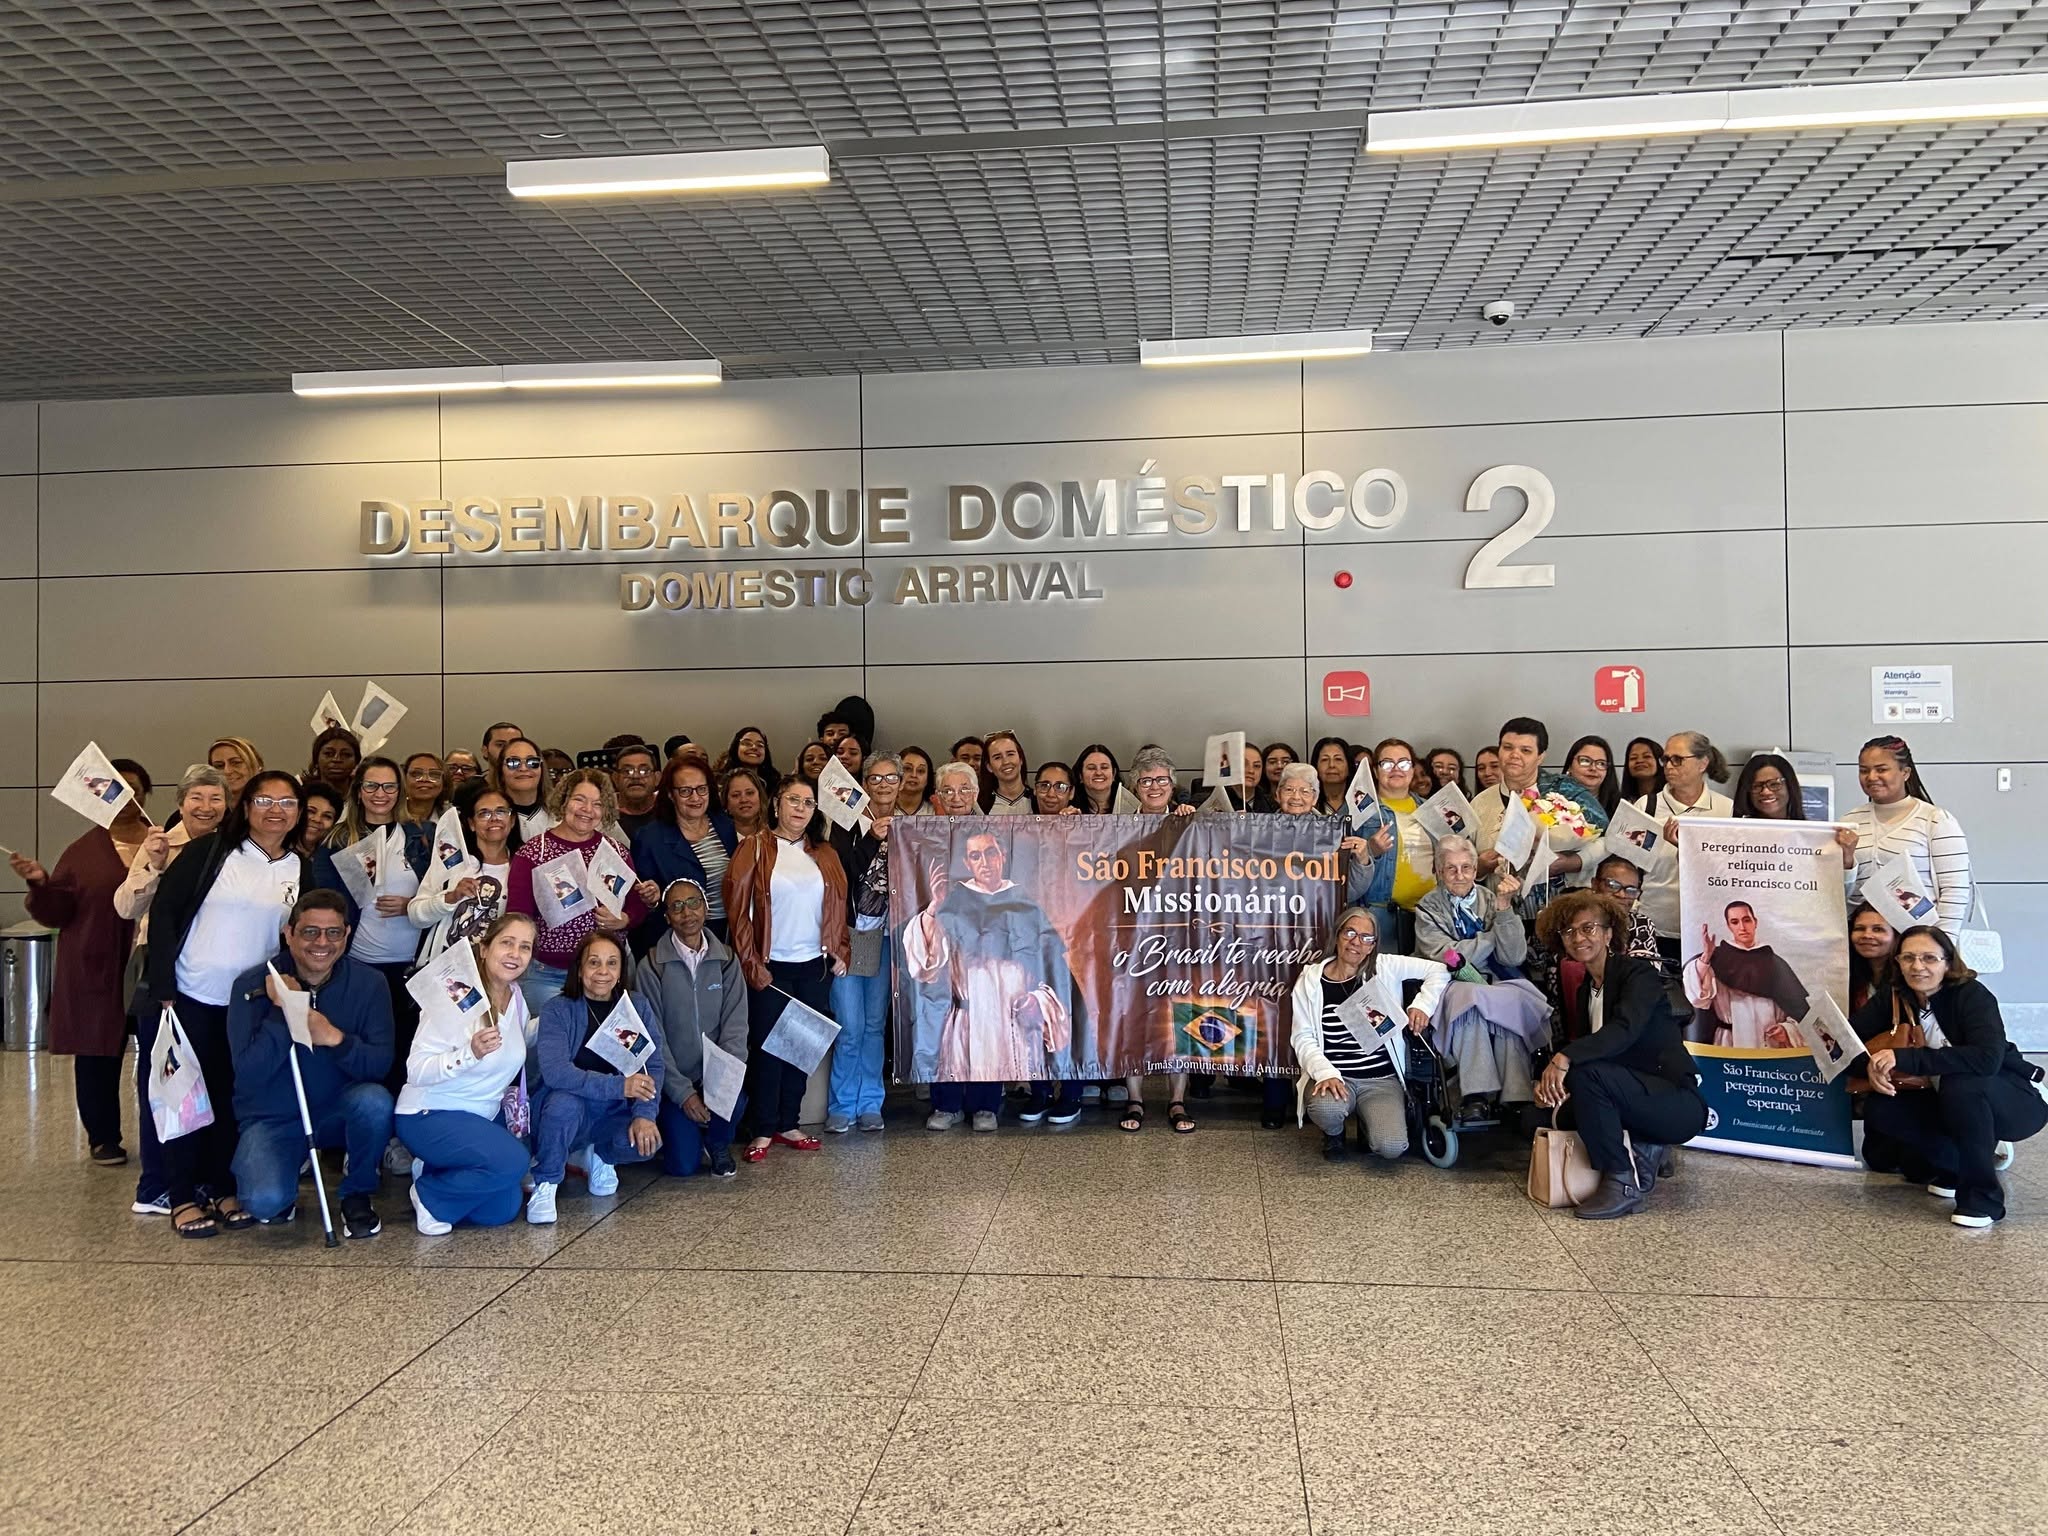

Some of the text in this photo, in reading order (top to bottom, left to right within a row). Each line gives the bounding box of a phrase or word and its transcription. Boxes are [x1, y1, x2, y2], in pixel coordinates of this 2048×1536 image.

[359, 459, 1408, 555] DESEMBARQUE DOMÉSTICO
[1464, 464, 1556, 590] 2
[621, 561, 1104, 612] DOMESTIC ARRIVAL
[1883, 670, 1921, 680] Atenção
[1600, 698, 1618, 706] ABC
[1701, 842, 1822, 856] Peregrinando com a
[1077, 849, 1347, 886] São Francisco Coll,
[1728, 859, 1793, 872] relíquia de
[1707, 876, 1818, 891] São Francisco Coll
[1123, 885, 1306, 915] Missionário
[1112, 934, 1323, 977] o Brasil te recebe
[1146, 979, 1193, 997] com
[1147, 1058, 1301, 1075] Irmãs Dominicanas da Anuncia
[1722, 1062, 1743, 1076] São
[1745, 1065, 1798, 1081] Francisco
[1725, 1081, 1824, 1101] peregrino de paz e
[1746, 1098, 1802, 1115] esperança
